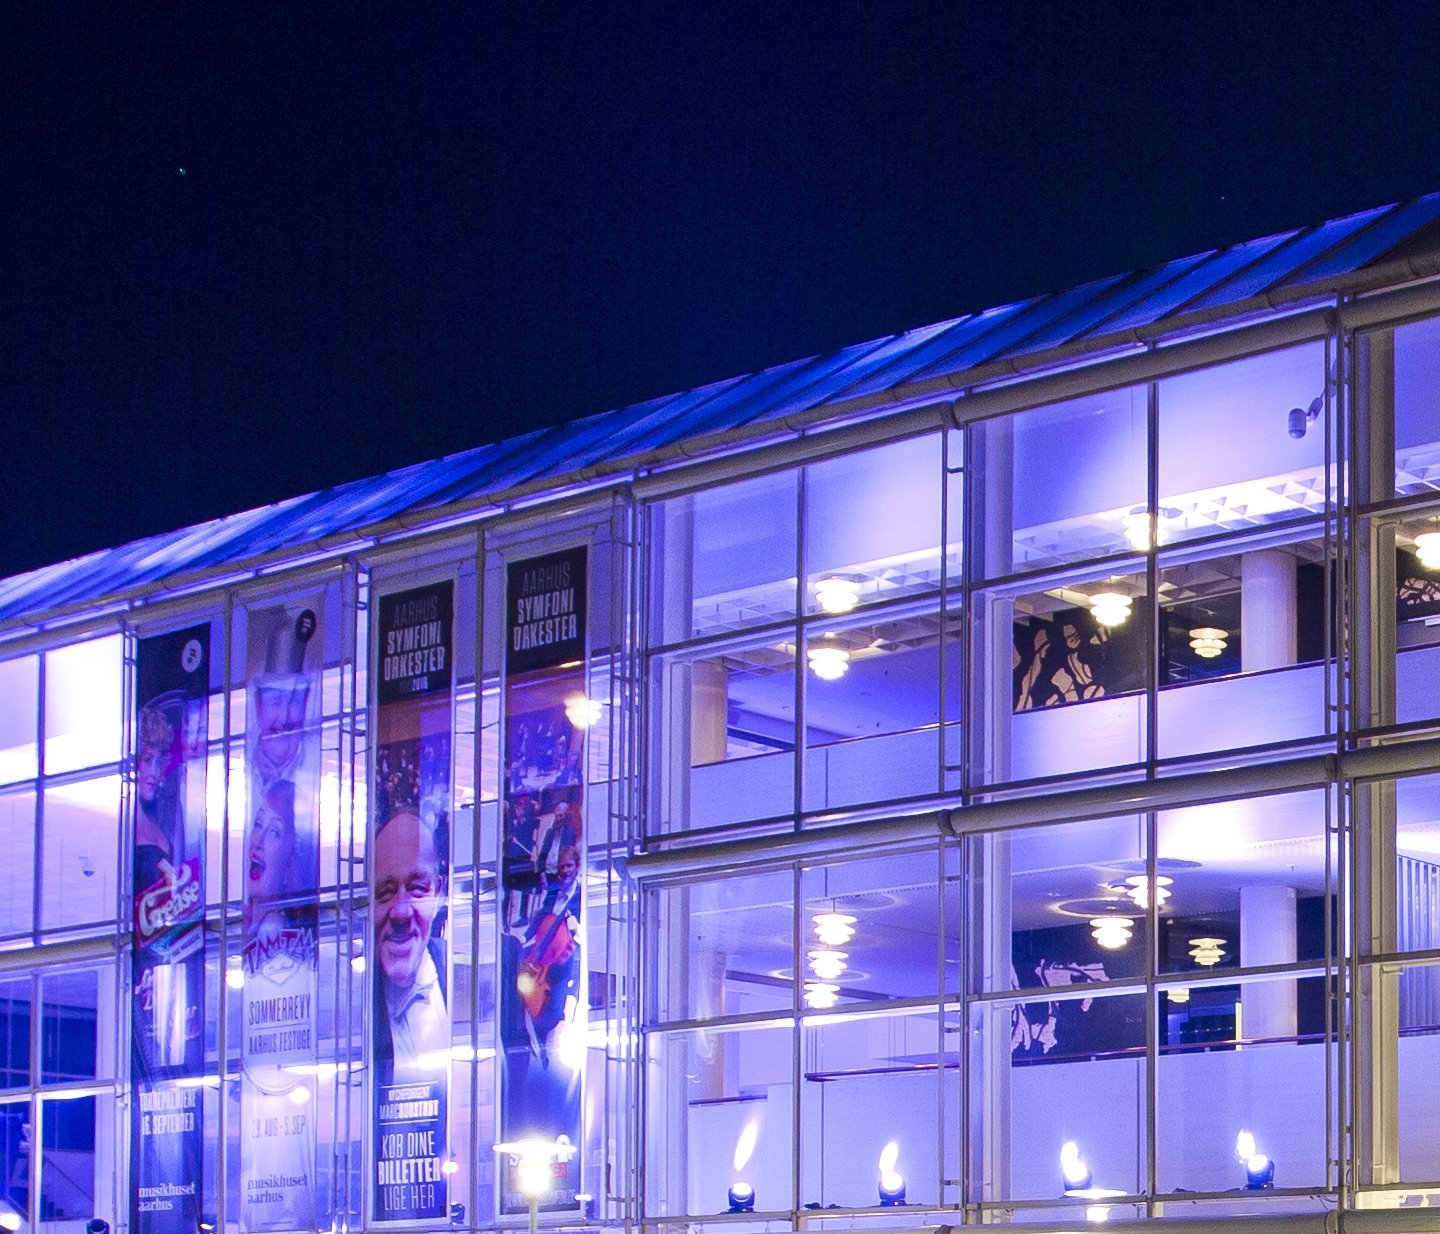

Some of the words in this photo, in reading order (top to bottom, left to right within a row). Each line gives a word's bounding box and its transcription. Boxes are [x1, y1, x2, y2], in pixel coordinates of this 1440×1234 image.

[522, 562, 570, 597] AARHUS
[393, 596, 438, 627] AARHUS
[517, 588, 575, 624] SYMFONI
[387, 620, 442, 654] SYMFONI
[513, 614, 577, 651] ORKESTER
[384, 646, 446, 681] ORKESTER
[138, 858, 201, 937] Grease
[249, 993, 312, 1026] SOMMERREVY
[279, 1029, 312, 1053] FESTUGE
[407, 1130, 436, 1158] DINE
[248, 1173, 308, 1190] musikhuset
[378, 1157, 441, 1185] BILLETTER
[139, 1181, 196, 1198] musikhuset
[248, 1190, 284, 1204] aarhus
[384, 1185, 407, 1211] LIGE
[411, 1183, 436, 1209] HER
[138, 1197, 174, 1212] aarhus
